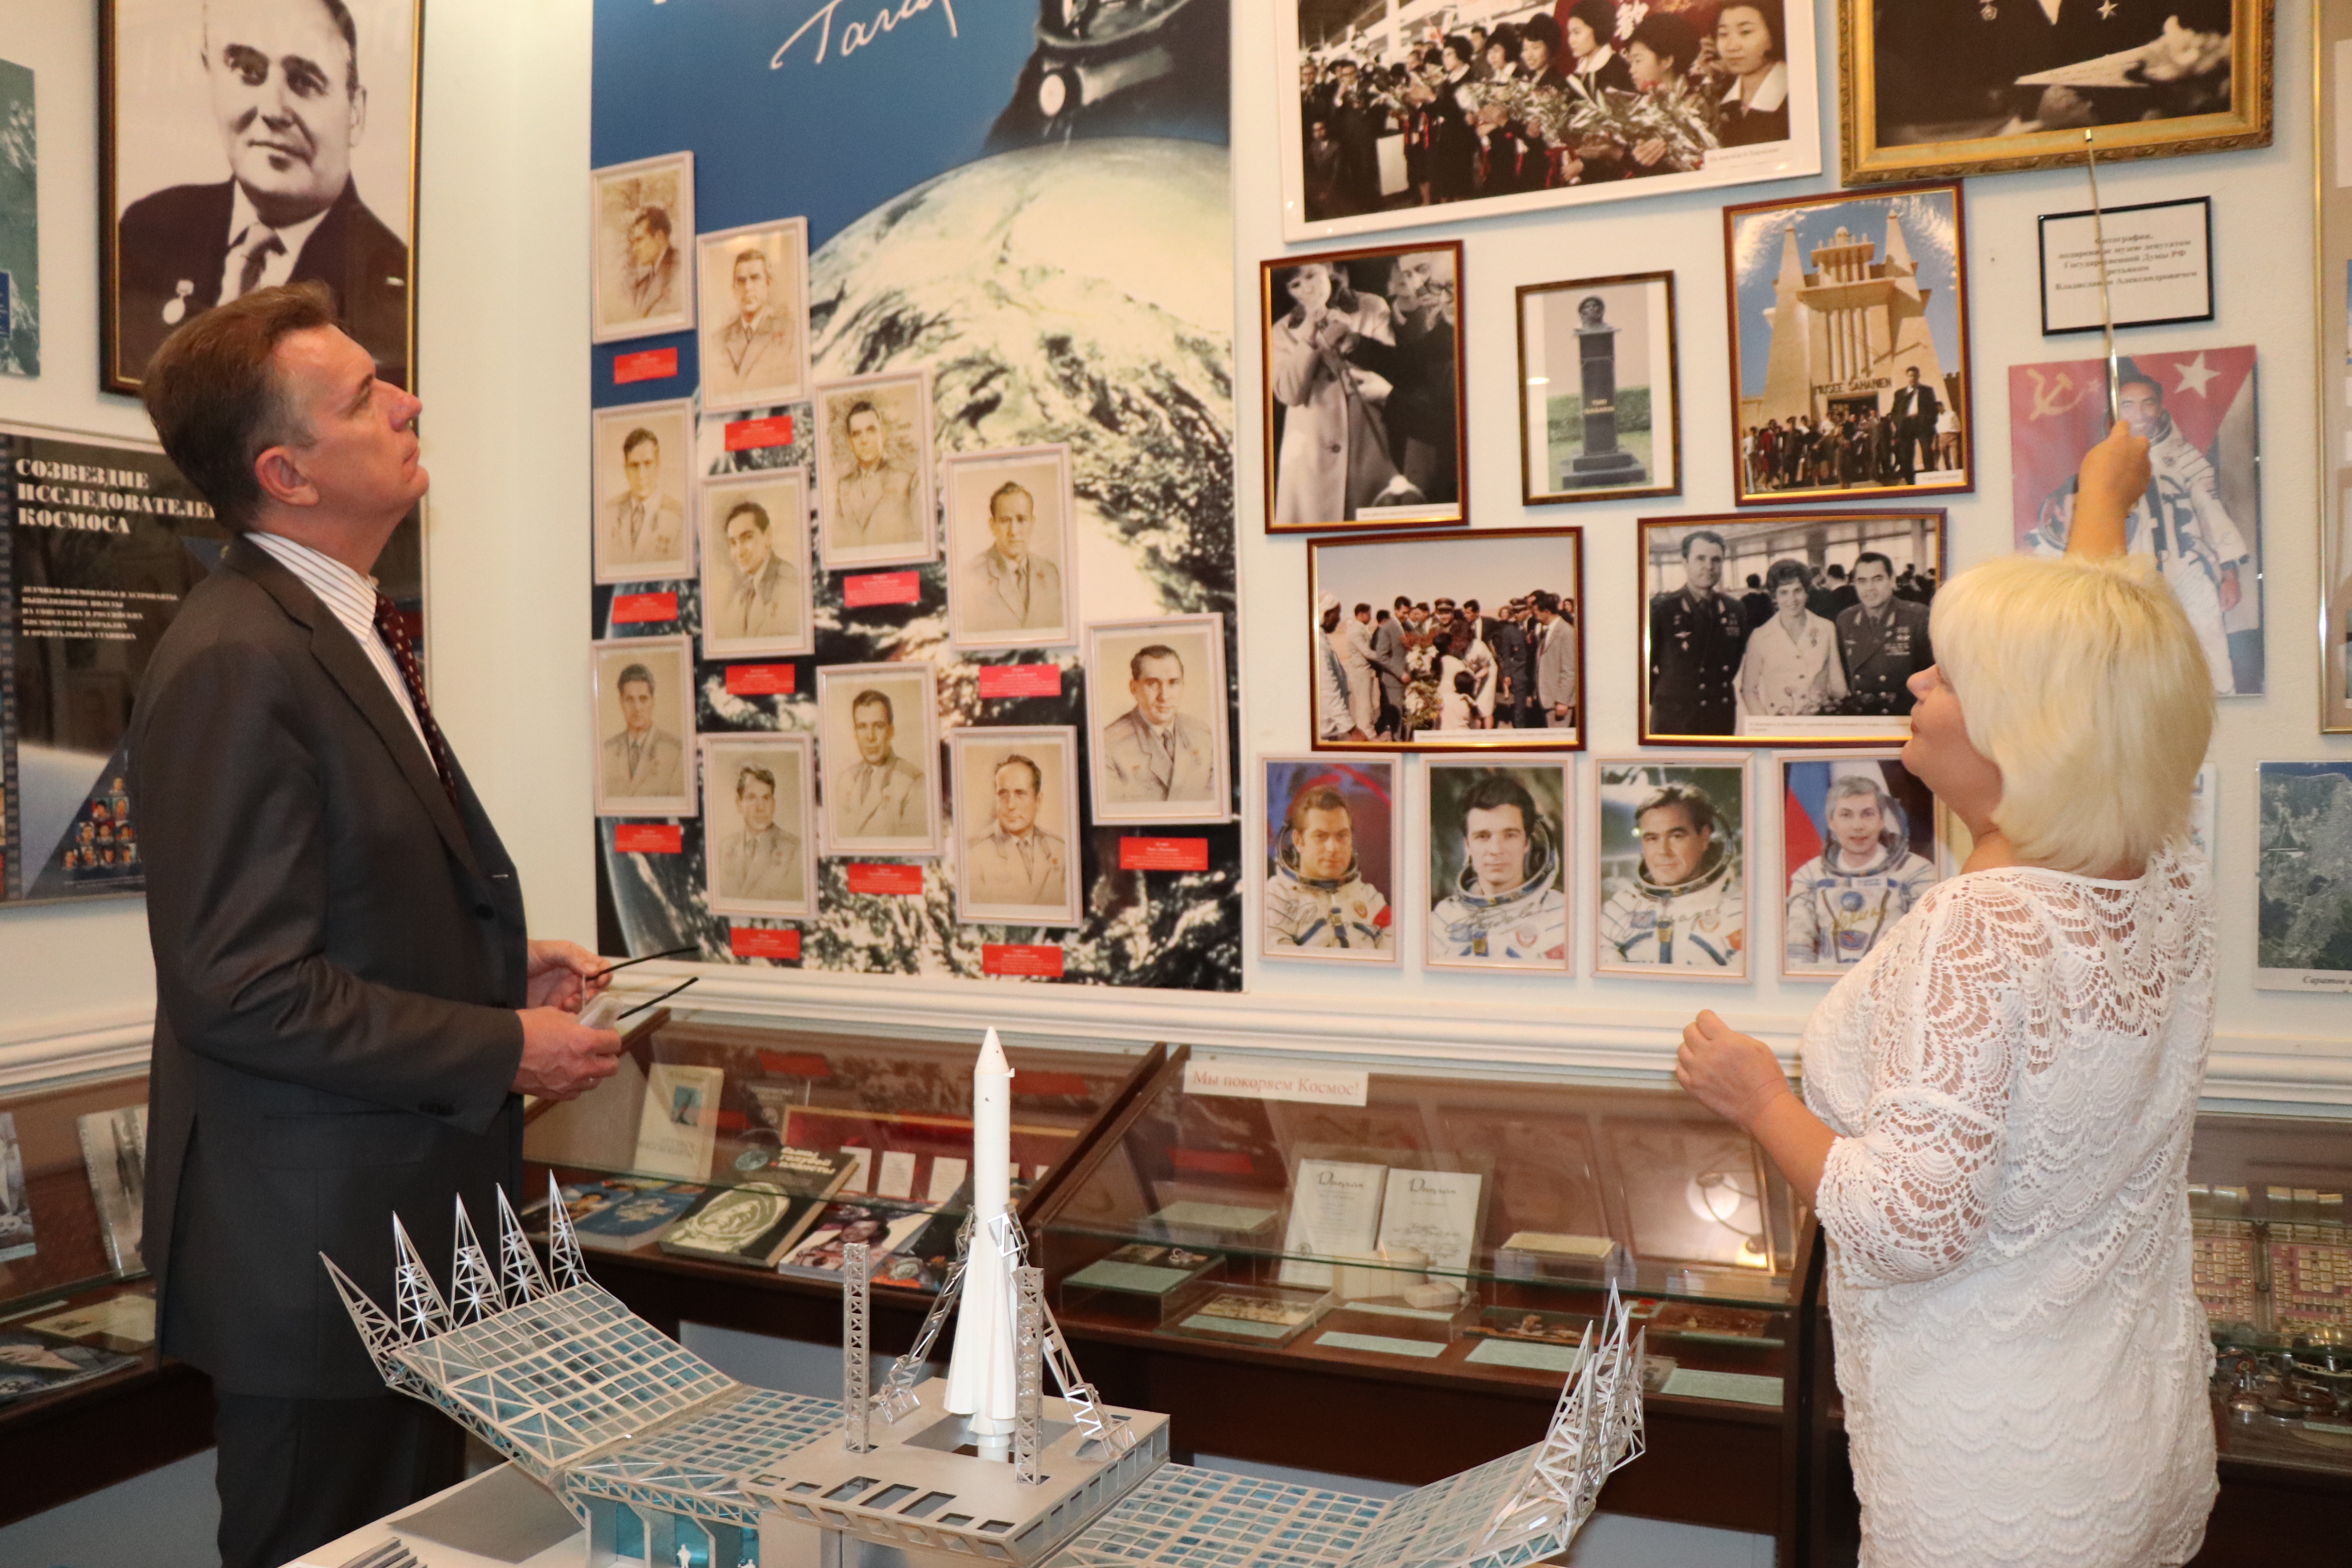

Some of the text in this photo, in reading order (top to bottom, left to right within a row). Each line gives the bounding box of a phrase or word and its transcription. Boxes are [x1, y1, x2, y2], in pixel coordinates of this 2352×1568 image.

[15, 458, 149, 489] СОЗВЕЗДИЕ
[18, 507, 130, 534] КОСМОСА
[1194, 1070, 1360, 1096] Мы покоряем Космос!
